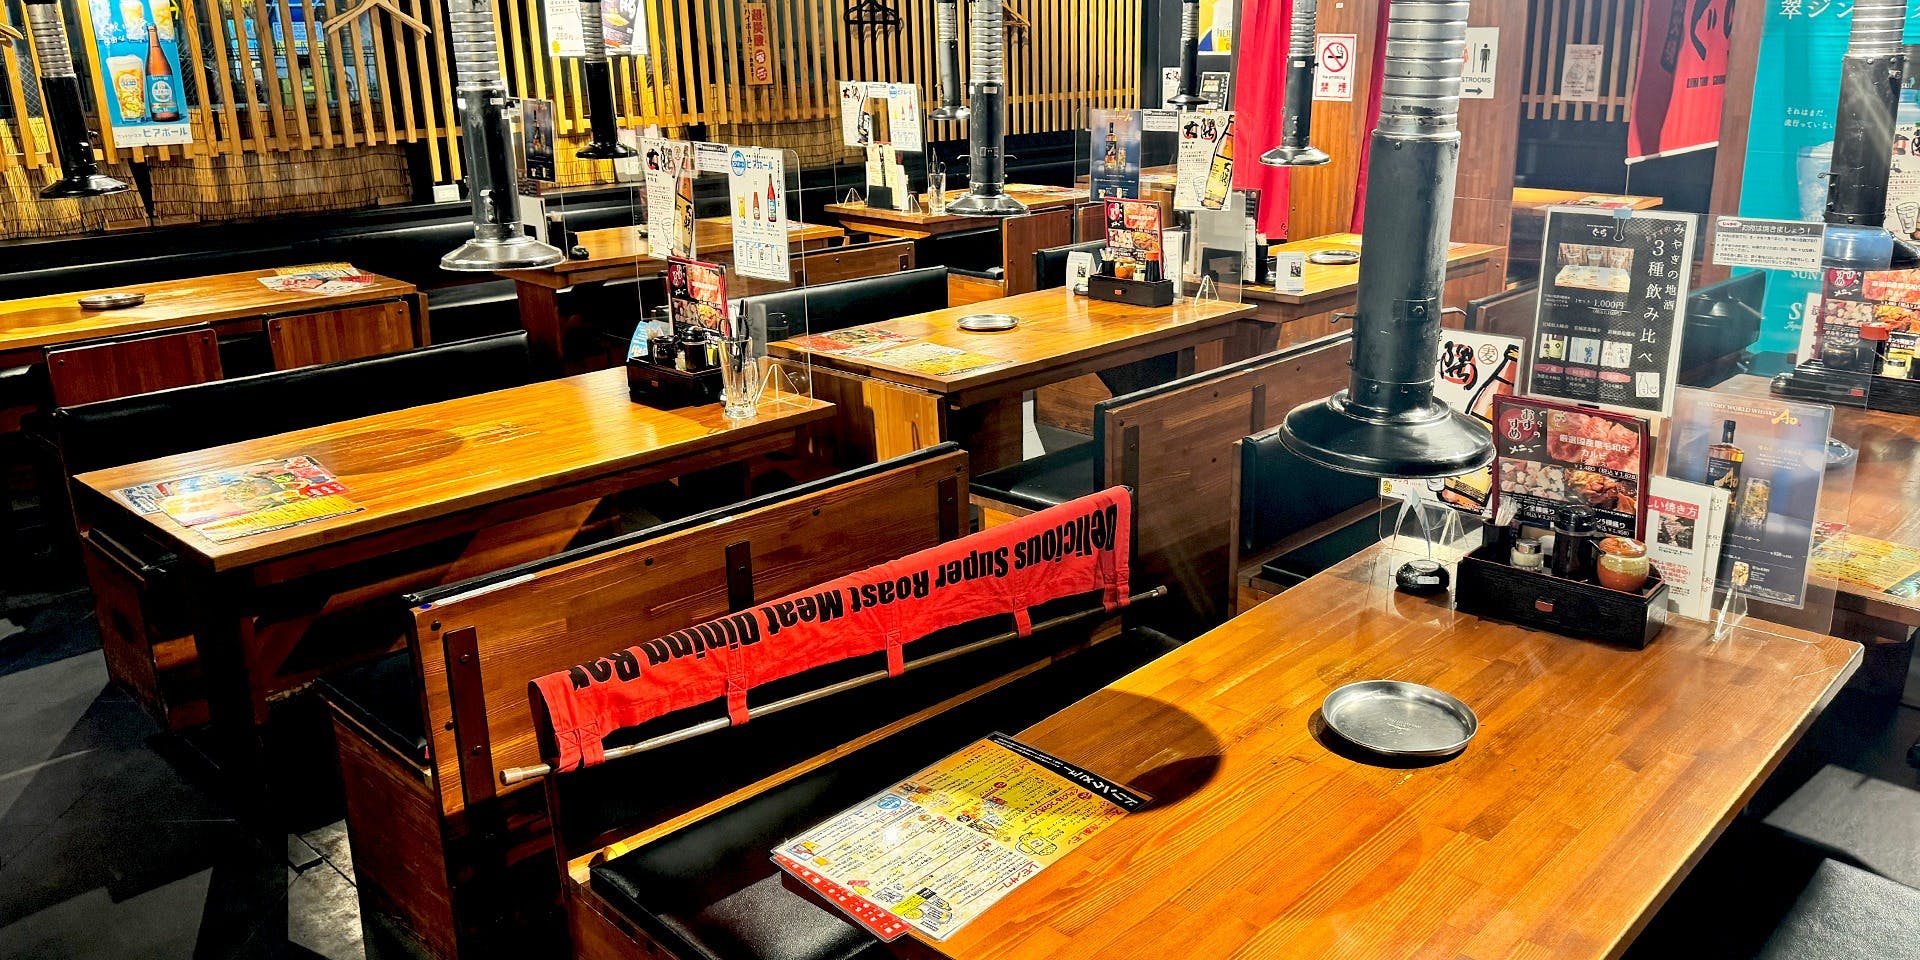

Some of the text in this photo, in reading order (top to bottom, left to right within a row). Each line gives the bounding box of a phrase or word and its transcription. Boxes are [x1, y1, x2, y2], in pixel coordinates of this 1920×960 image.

[1663, 224, 1686, 310] みやぎの地酒
[1637, 240, 1665, 363] 3種飲み比べ
[1507, 408, 1535, 440] おすすめ
[1727, 404, 1751, 413] WORLD
[1752, 407, 1777, 417] WHISKY
[1771, 408, 1798, 425] Ao
[1508, 444, 1542, 455] メニュー
[1581, 449, 1609, 461] カルビ
[1013, 503, 1118, 572] Delicious
[936, 547, 1009, 590] Super
[764, 589, 844, 637] Meat
[849, 570, 930, 614] Roast
[1056, 764, 1141, 807] ドリンクメニュー
